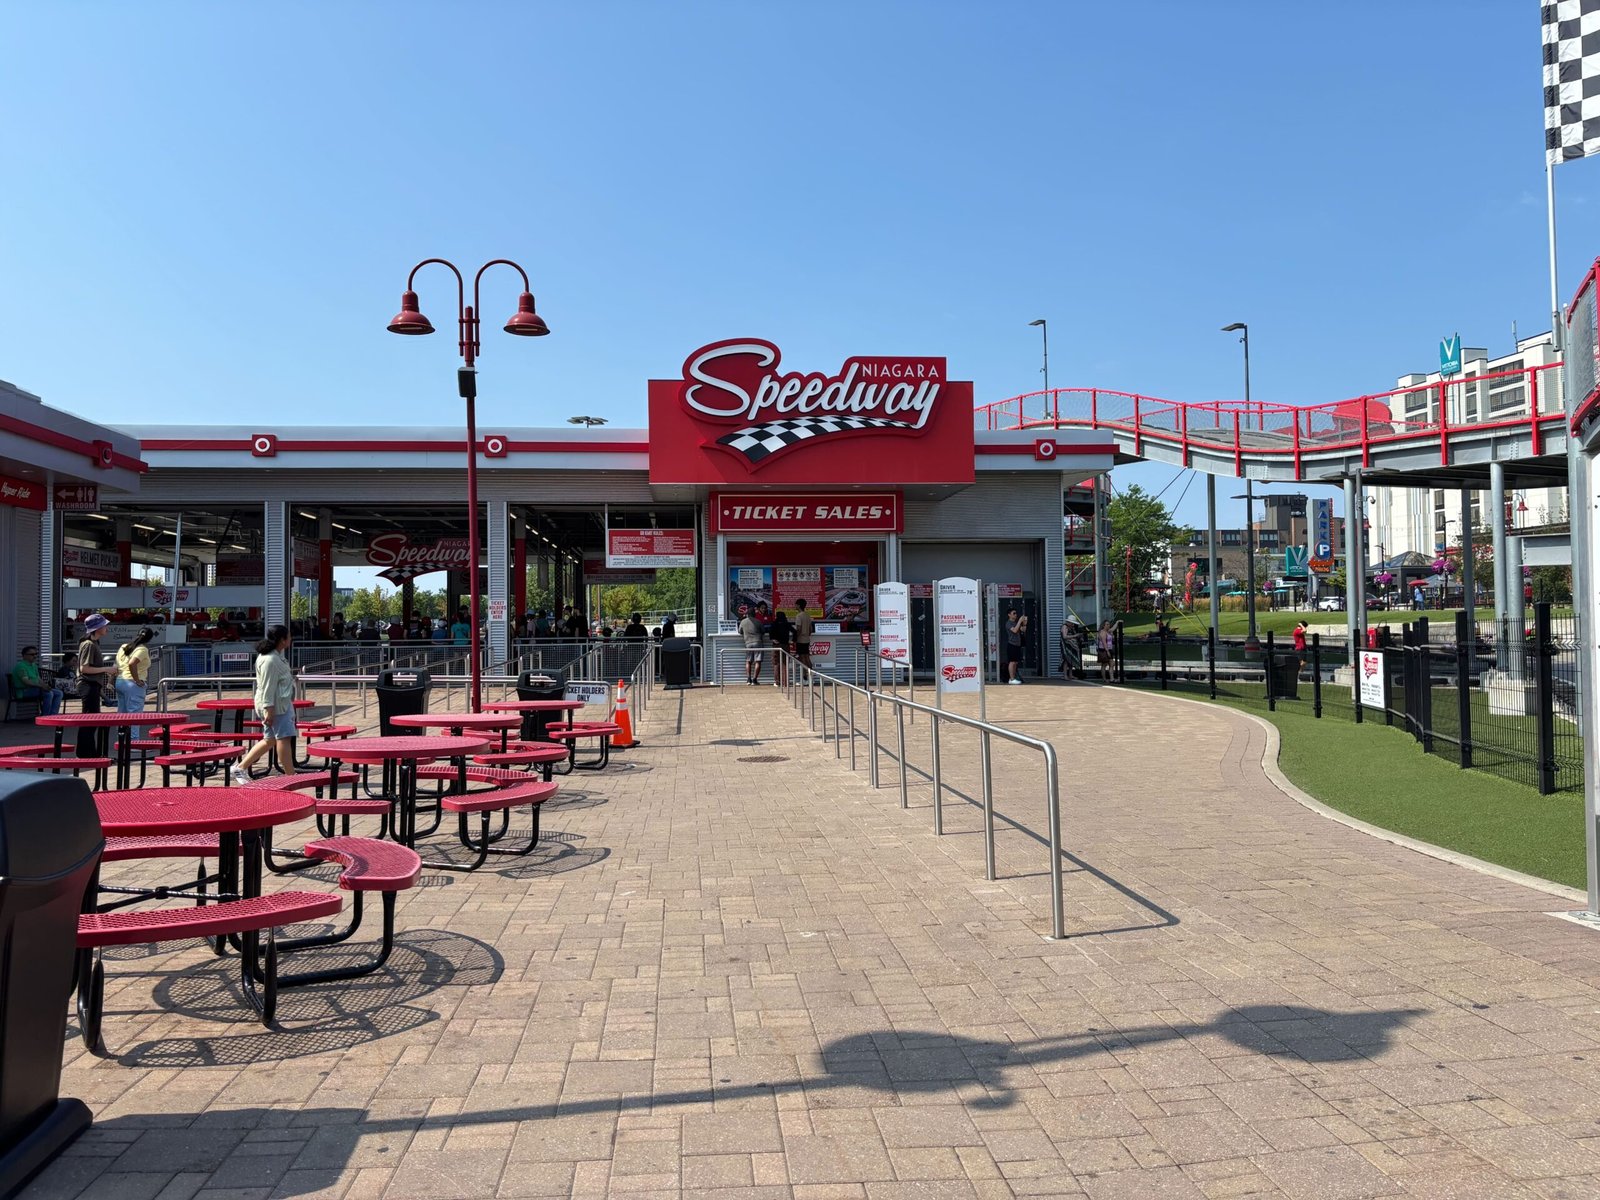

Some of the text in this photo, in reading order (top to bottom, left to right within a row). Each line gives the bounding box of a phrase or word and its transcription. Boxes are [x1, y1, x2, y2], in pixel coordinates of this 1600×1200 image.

[861, 363, 939, 378] NIAGARA
[685, 344, 940, 429] Speedway
[17, 487, 31, 499] Ride
[731, 506, 883, 520] TICKET SALES
[1318, 501, 1328, 540] PARK
[80, 551, 100, 566] HELMET
[100, 553, 118, 568] PICK-UP
[568, 686, 605, 695] CKET HOLDERS
[577, 694, 591, 702] ONLY
